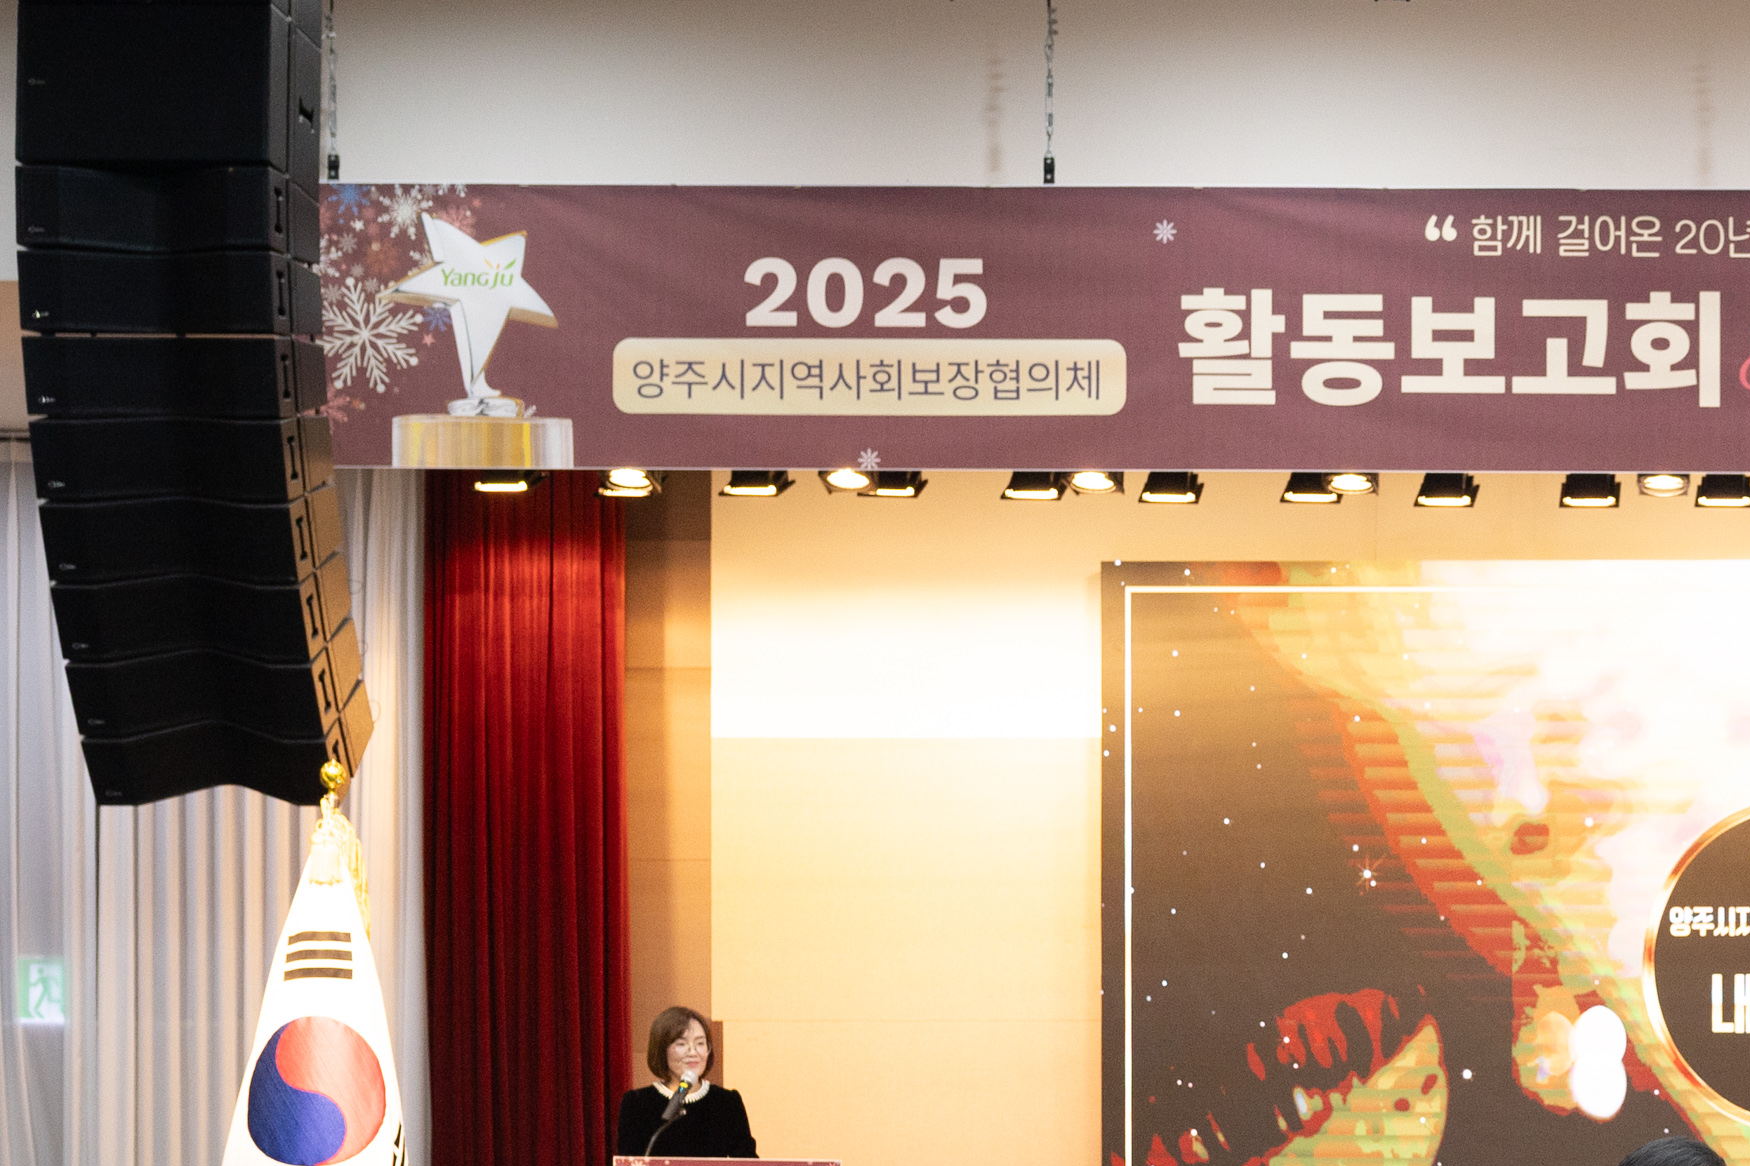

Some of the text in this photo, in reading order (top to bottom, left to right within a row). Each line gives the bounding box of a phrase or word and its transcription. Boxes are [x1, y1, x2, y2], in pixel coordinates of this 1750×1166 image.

[1557, 215, 1663, 259] 걸어온
[744, 257, 988, 329] 2025
[1177, 287, 1723, 409] 활동보고회
[632, 358, 1102, 402] 양주시지역사회보장협의체
